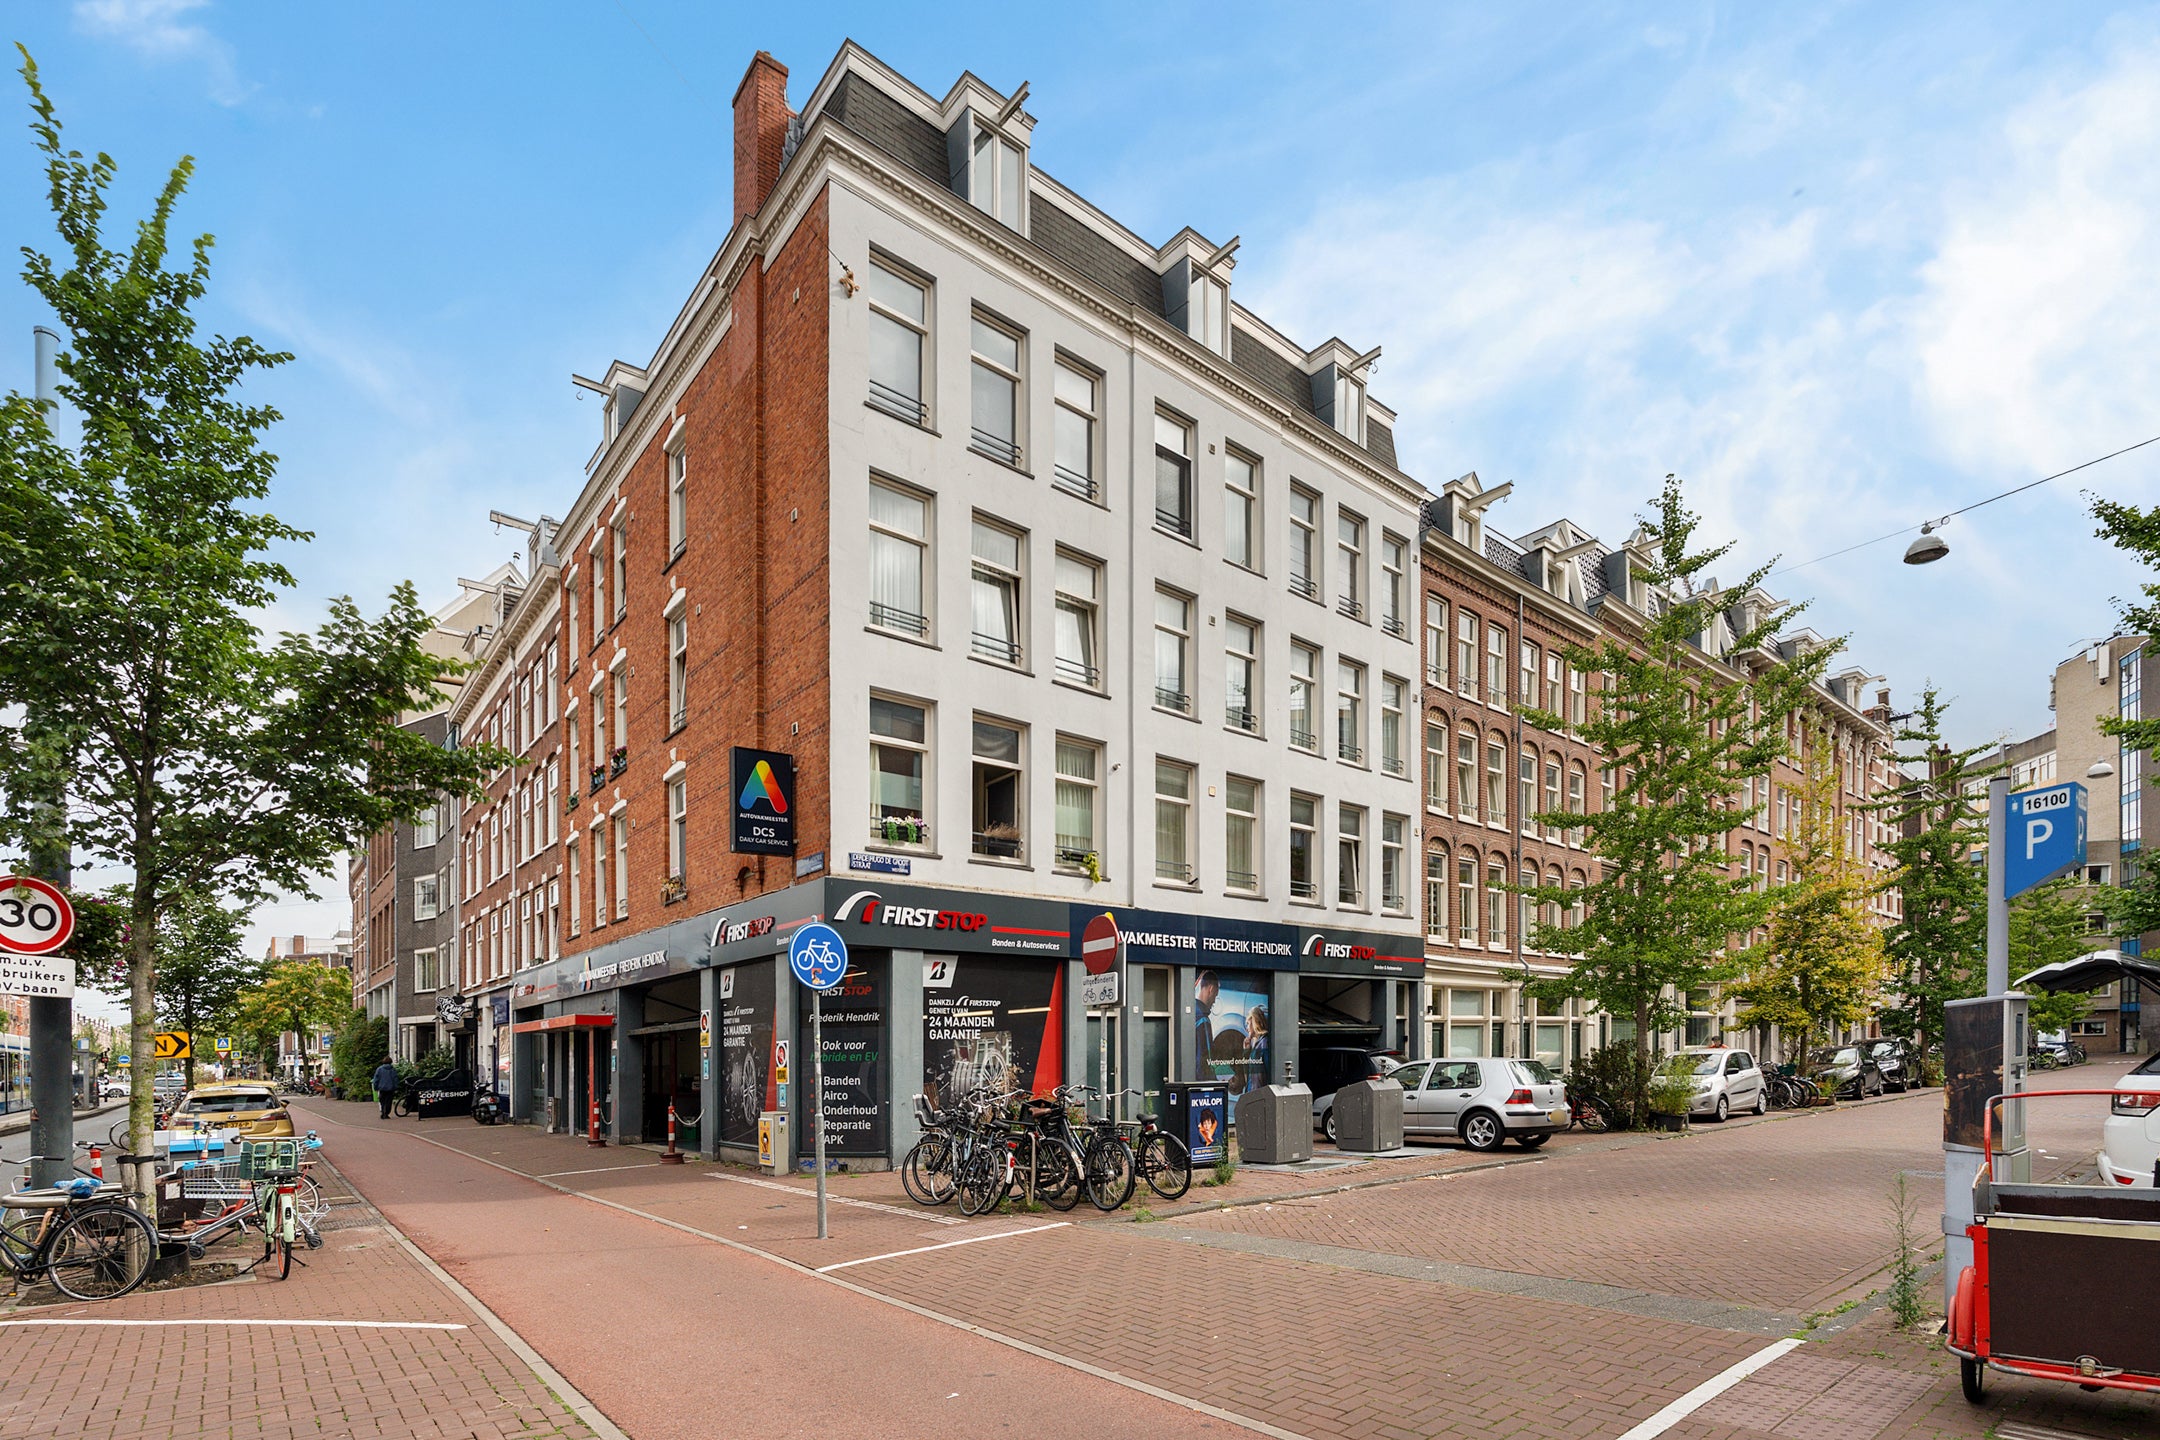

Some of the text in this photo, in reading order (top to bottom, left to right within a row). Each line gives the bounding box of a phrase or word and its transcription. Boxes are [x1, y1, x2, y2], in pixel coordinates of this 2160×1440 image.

[2025, 792, 2068, 810] 16100
[739, 812, 788, 823] AUTOVAKMEESTER
[752, 826, 775, 838] DCS
[739, 836, 754, 844] DAILY
[767, 838, 788, 847] SERVICE
[2026, 819, 2053, 859] P
[0, 899, 57, 931] 30
[882, 905, 988, 931] FIRSTSTOP
[991, 938, 1060, 950] Banden & Autoservices
[1118, 931, 1293, 957] VAKMEESTER FREDERIK HENDRIK
[1324, 943, 1376, 960] FIRSTSTOP
[0, 968, 66, 982] bruikers
[0, 982, 58, 995] V-baan
[817, 985, 873, 997] IRSTSTOP
[928, 998, 955, 1006] DANKZIJ
[808, 1012, 880, 1023] Federik Hendrik
[929, 1016, 995, 1027] 24 MAANDEN
[929, 1029, 981, 1040] GARANTIE
[822, 1040, 867, 1050] Ook voor
[810, 1052, 879, 1063] hbride en EV
[1206, 1057, 1235, 1066] Vertrouwd
[823, 1075, 861, 1086] Banden
[421, 1091, 470, 1099] COFFEESHOP
[823, 1091, 848, 1101] Airco
[1191, 1099, 1199, 1107] IK
[1199, 1098, 1211, 1107] VAL
[823, 1104, 878, 1115] Onderhoud
[824, 1120, 871, 1132] Reparatie
[824, 1135, 844, 1145] APK
